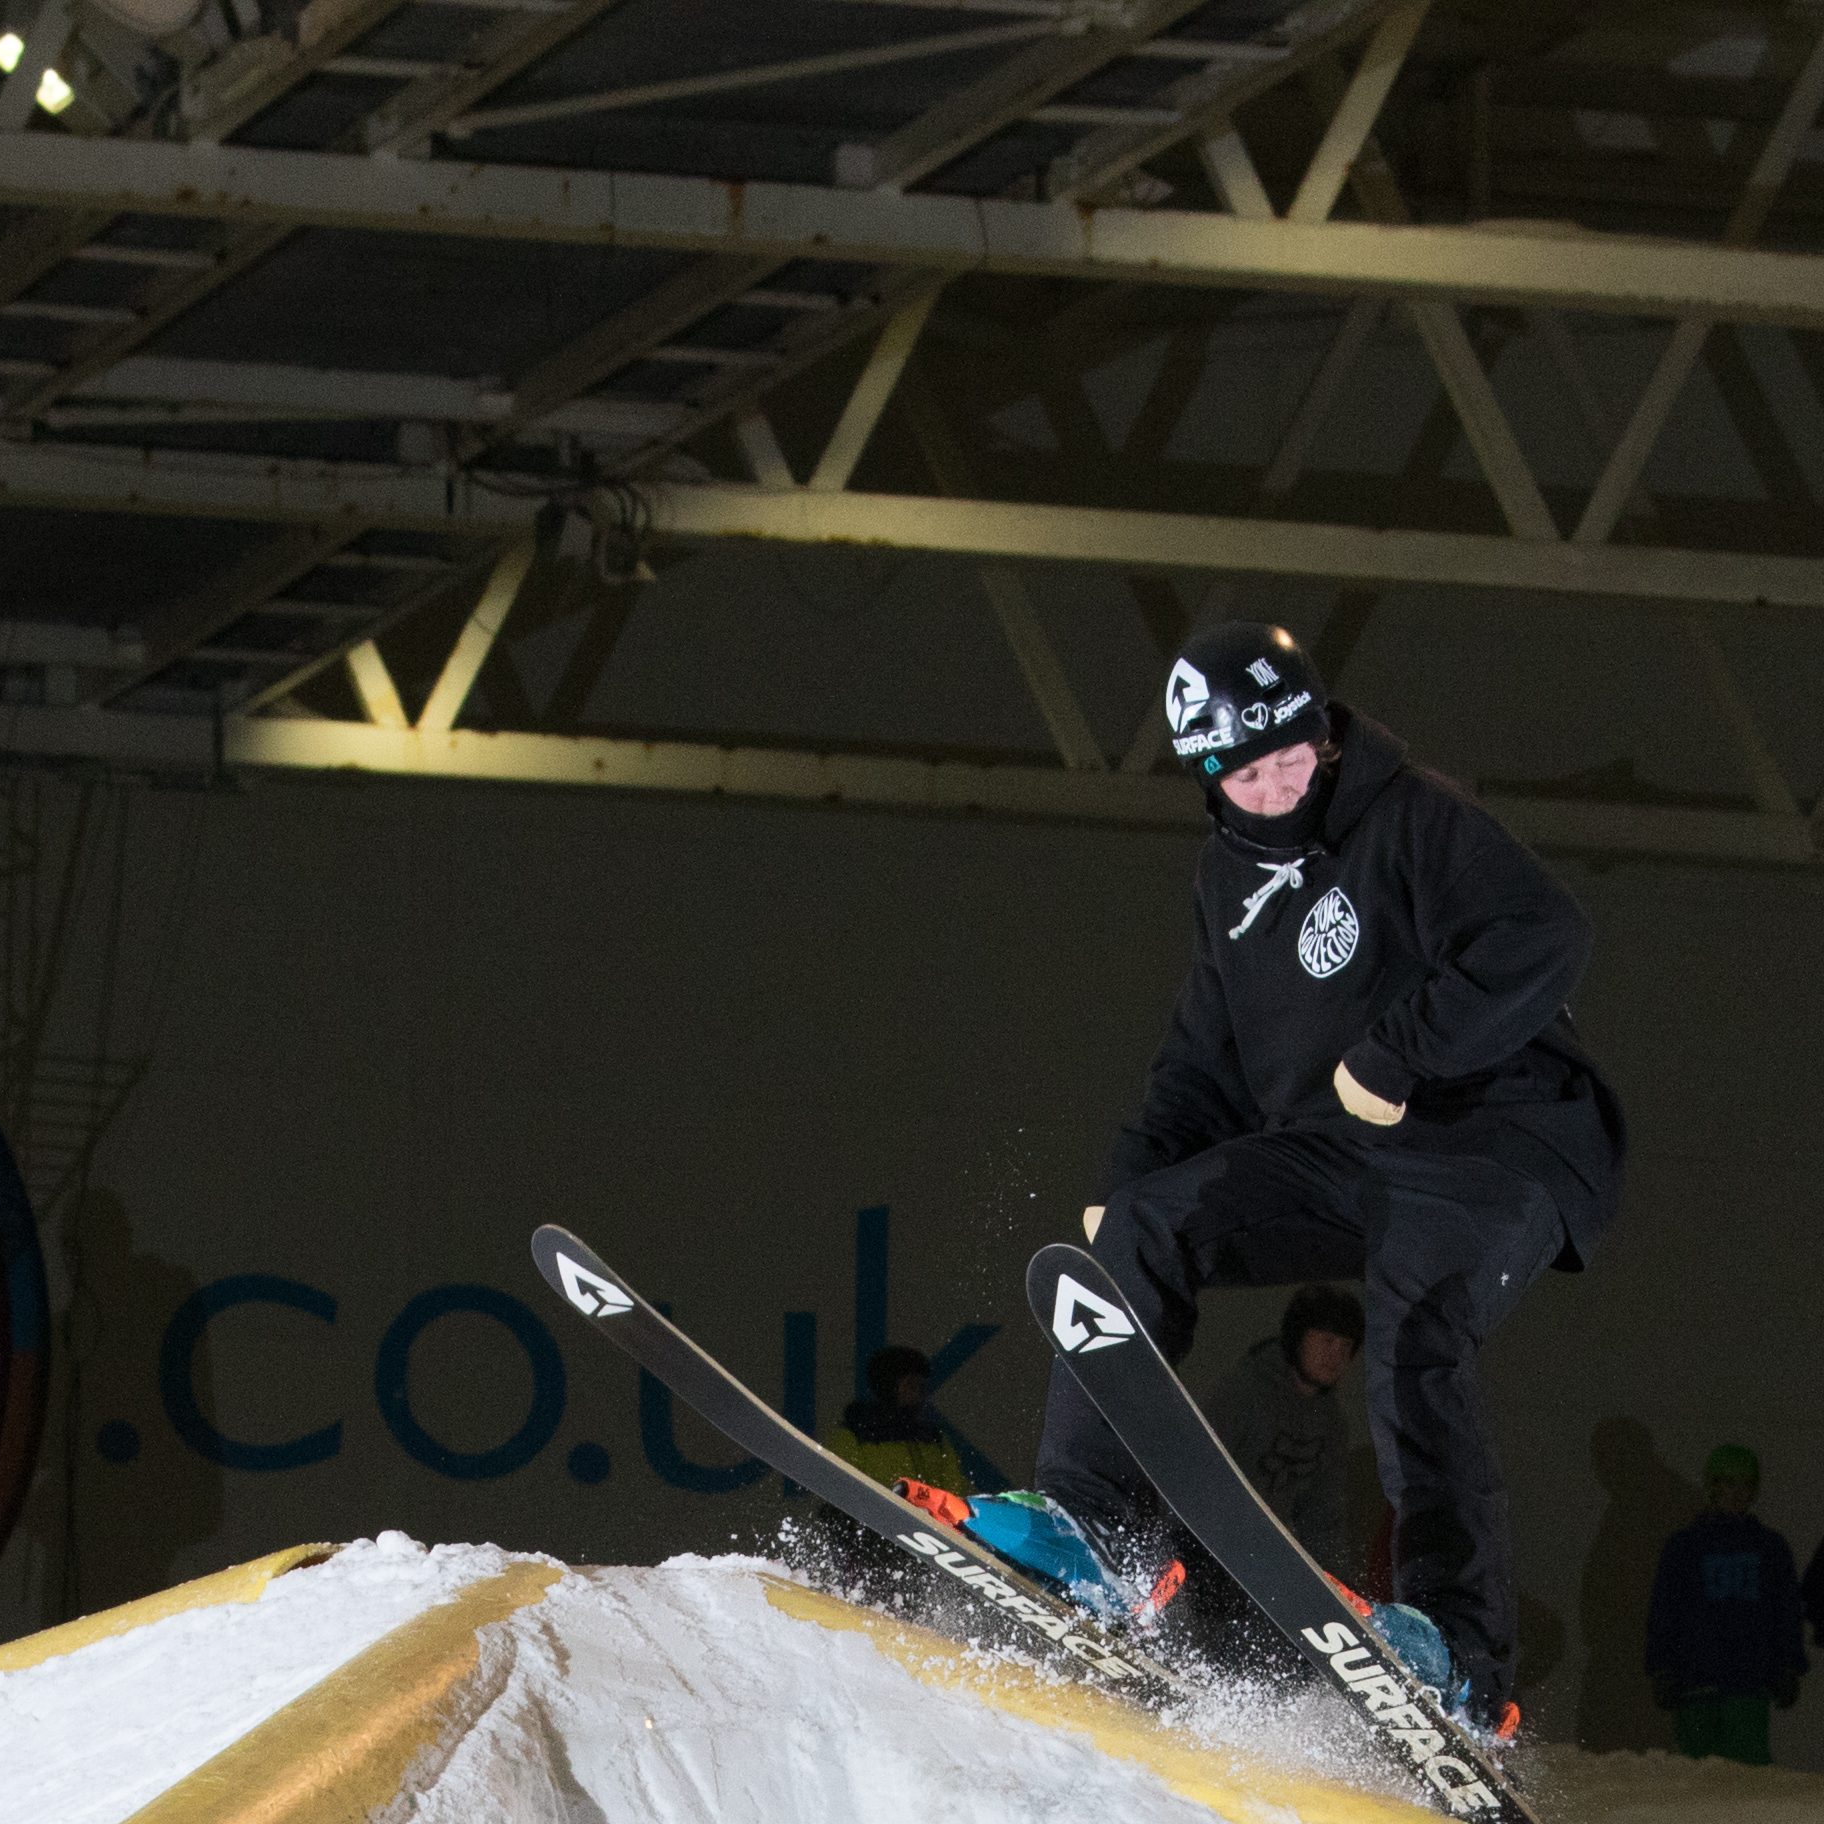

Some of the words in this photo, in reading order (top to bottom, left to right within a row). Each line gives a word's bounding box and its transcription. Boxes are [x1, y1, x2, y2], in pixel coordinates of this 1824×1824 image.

[1301, 912, 1357, 973] COLLECTION
[1313, 892, 1345, 935] YOKE
[896, 1531, 1144, 1680] SURFACE
[1300, 1621, 1503, 1814] SURFACE
